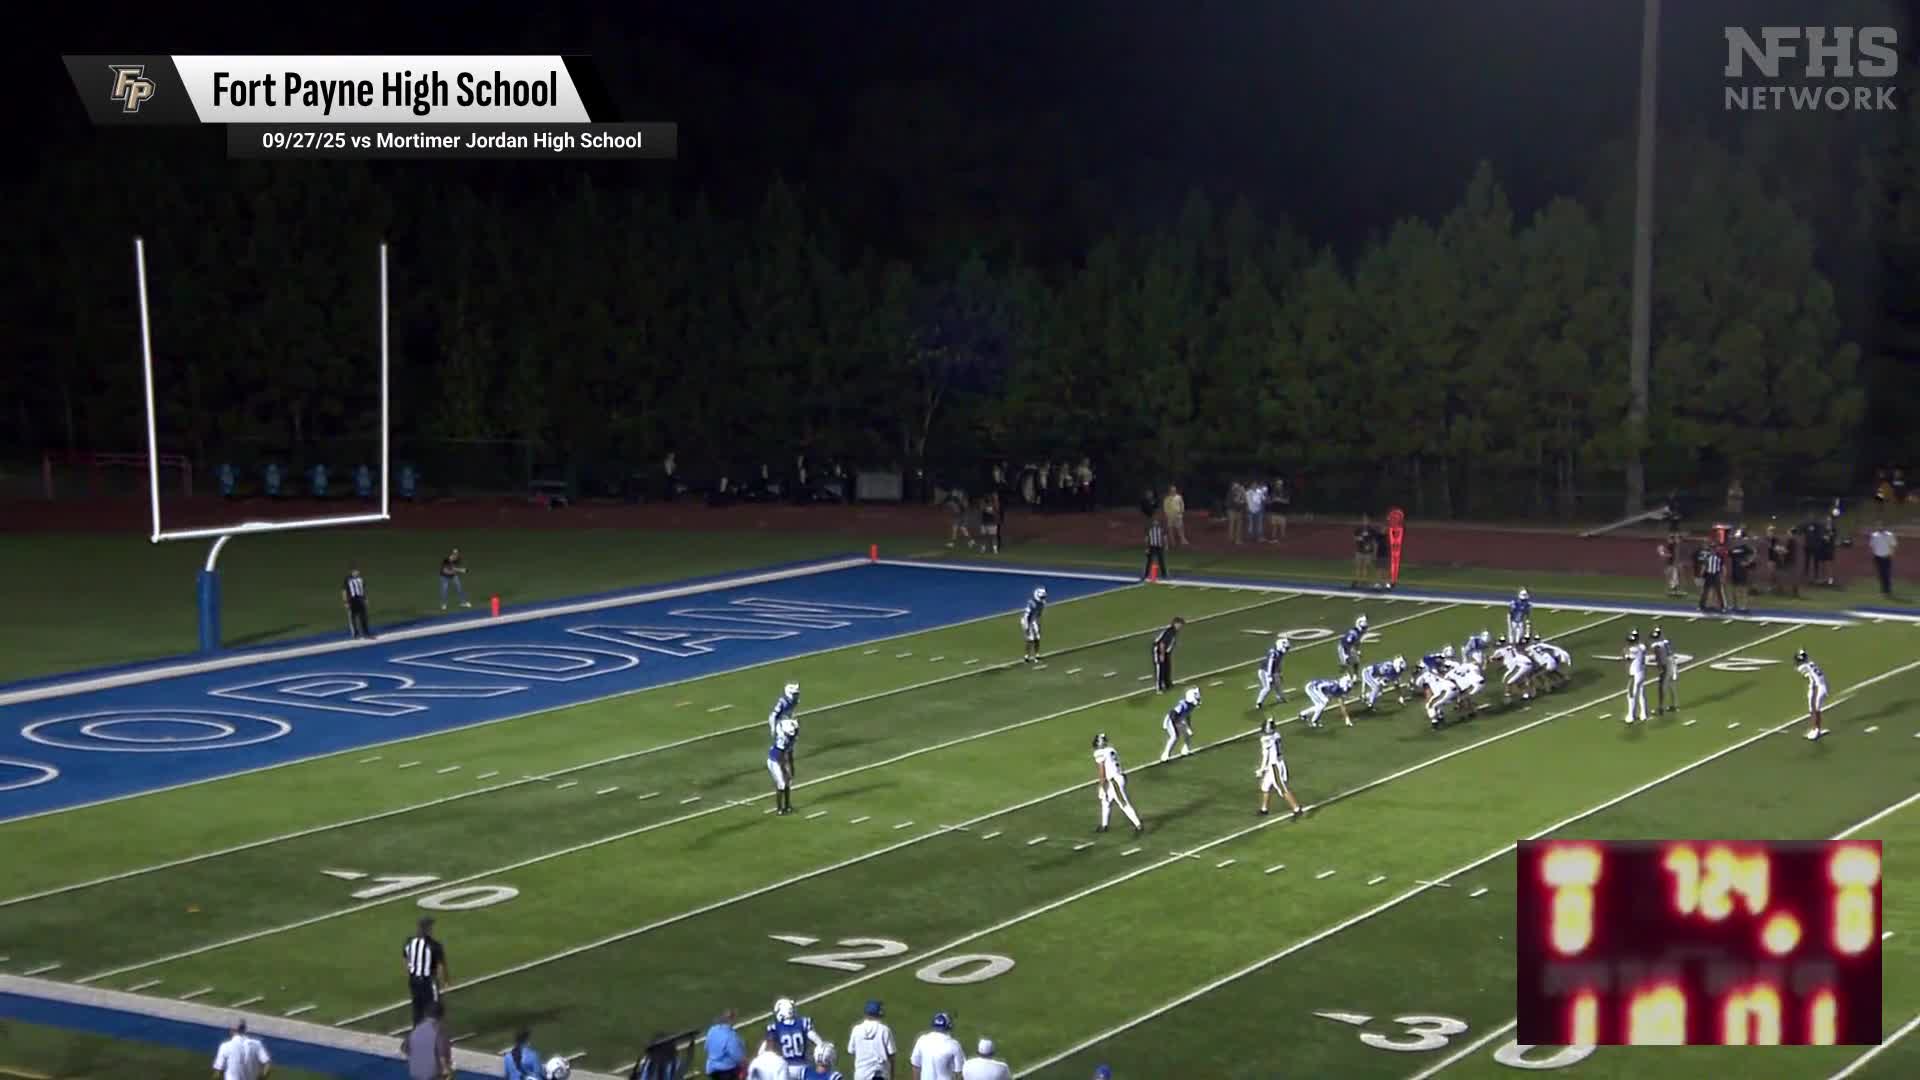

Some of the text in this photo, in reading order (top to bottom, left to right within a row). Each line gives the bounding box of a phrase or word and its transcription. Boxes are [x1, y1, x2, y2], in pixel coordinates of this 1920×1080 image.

[350, 876, 520, 911] 10
[787, 938, 1016, 984] 20
[780, 1032, 804, 1058] 20
